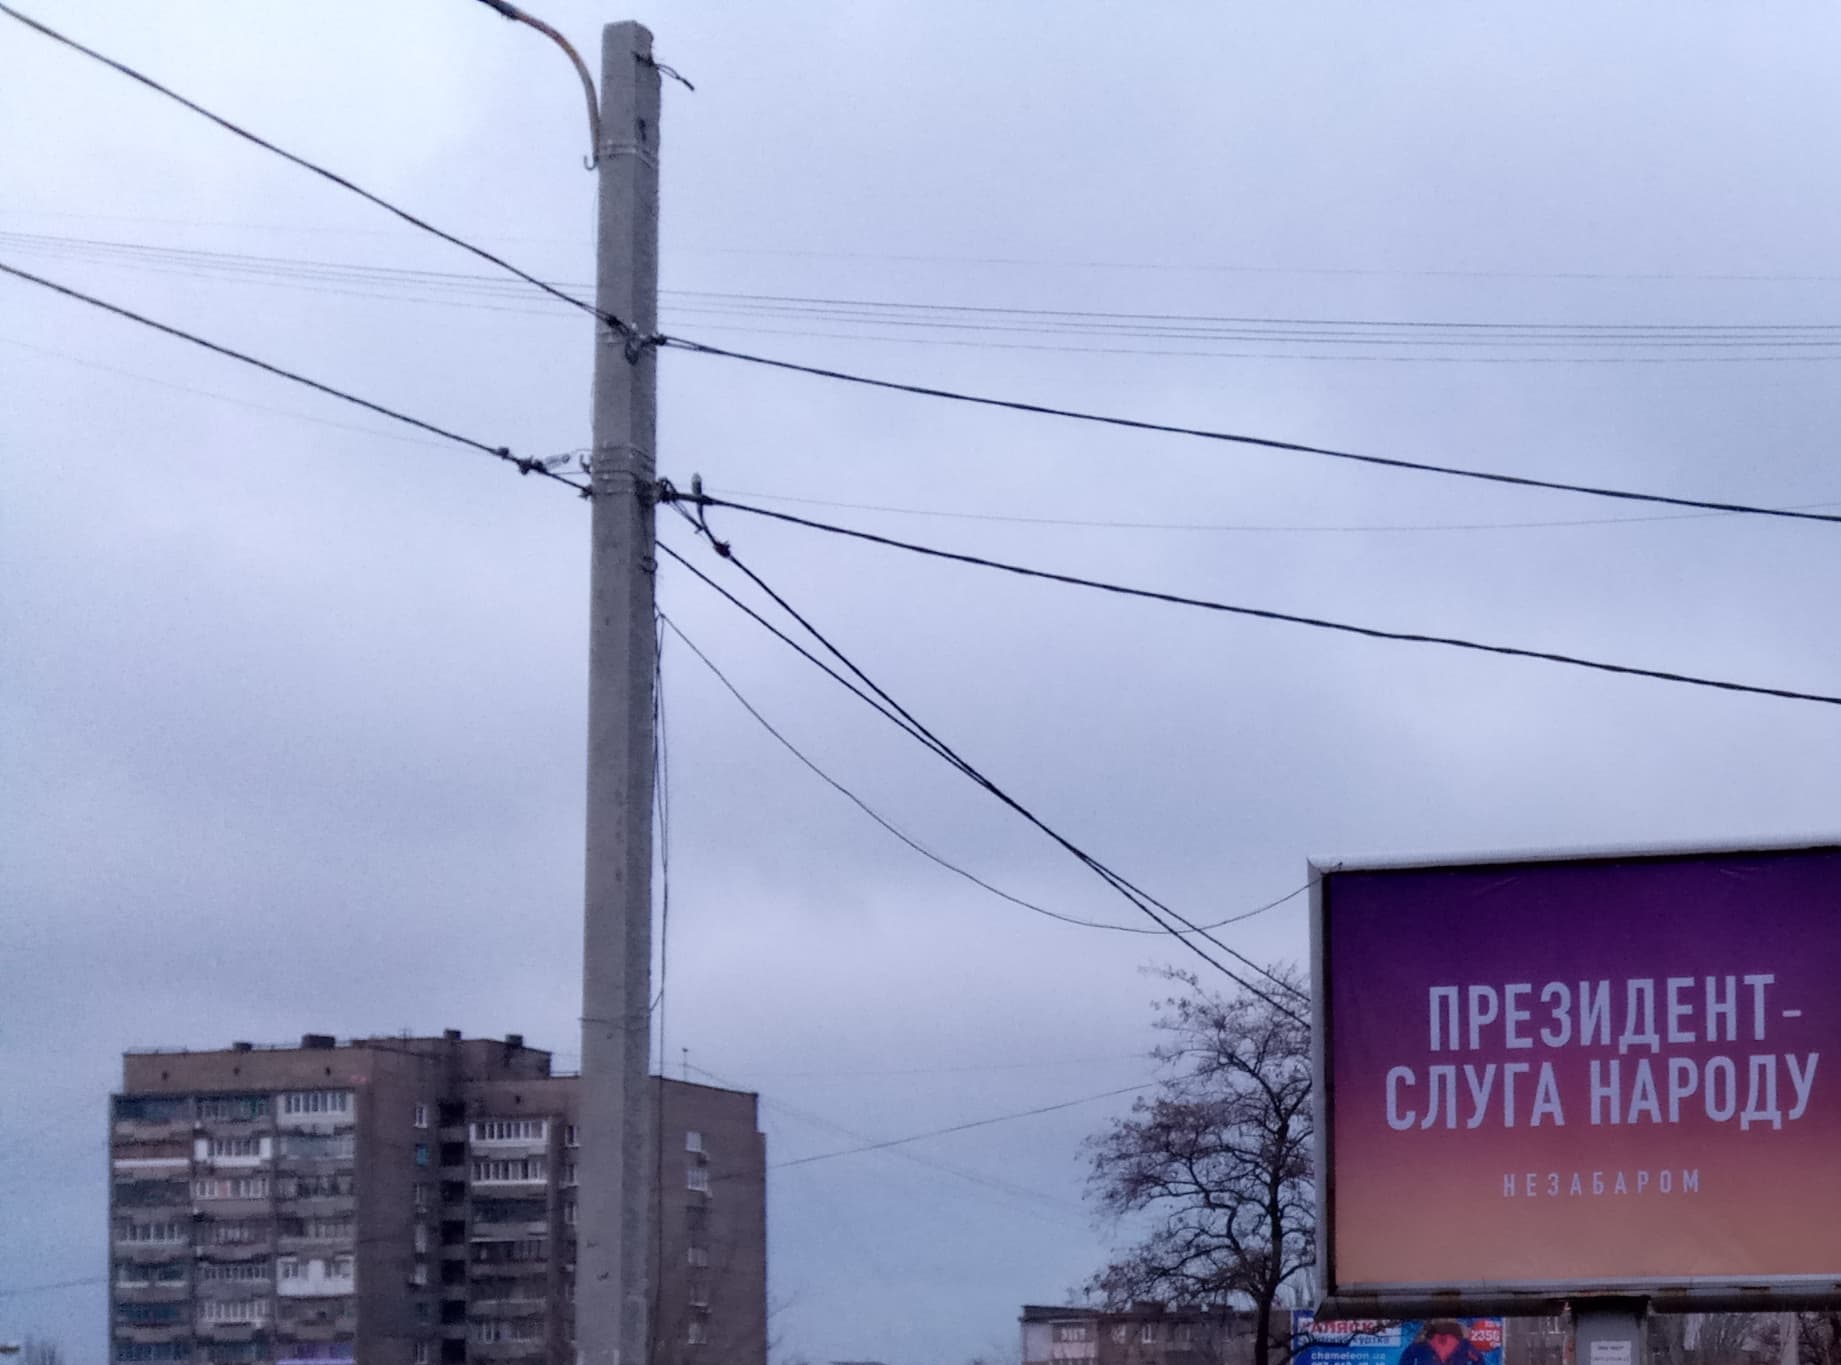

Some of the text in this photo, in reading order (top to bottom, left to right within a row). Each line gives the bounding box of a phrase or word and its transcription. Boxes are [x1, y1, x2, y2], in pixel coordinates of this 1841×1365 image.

[1385, 1052, 1821, 1131] СЛУГА НАРОДУ
[1502, 1169, 1700, 1198] НЕЗАБАРОМ
